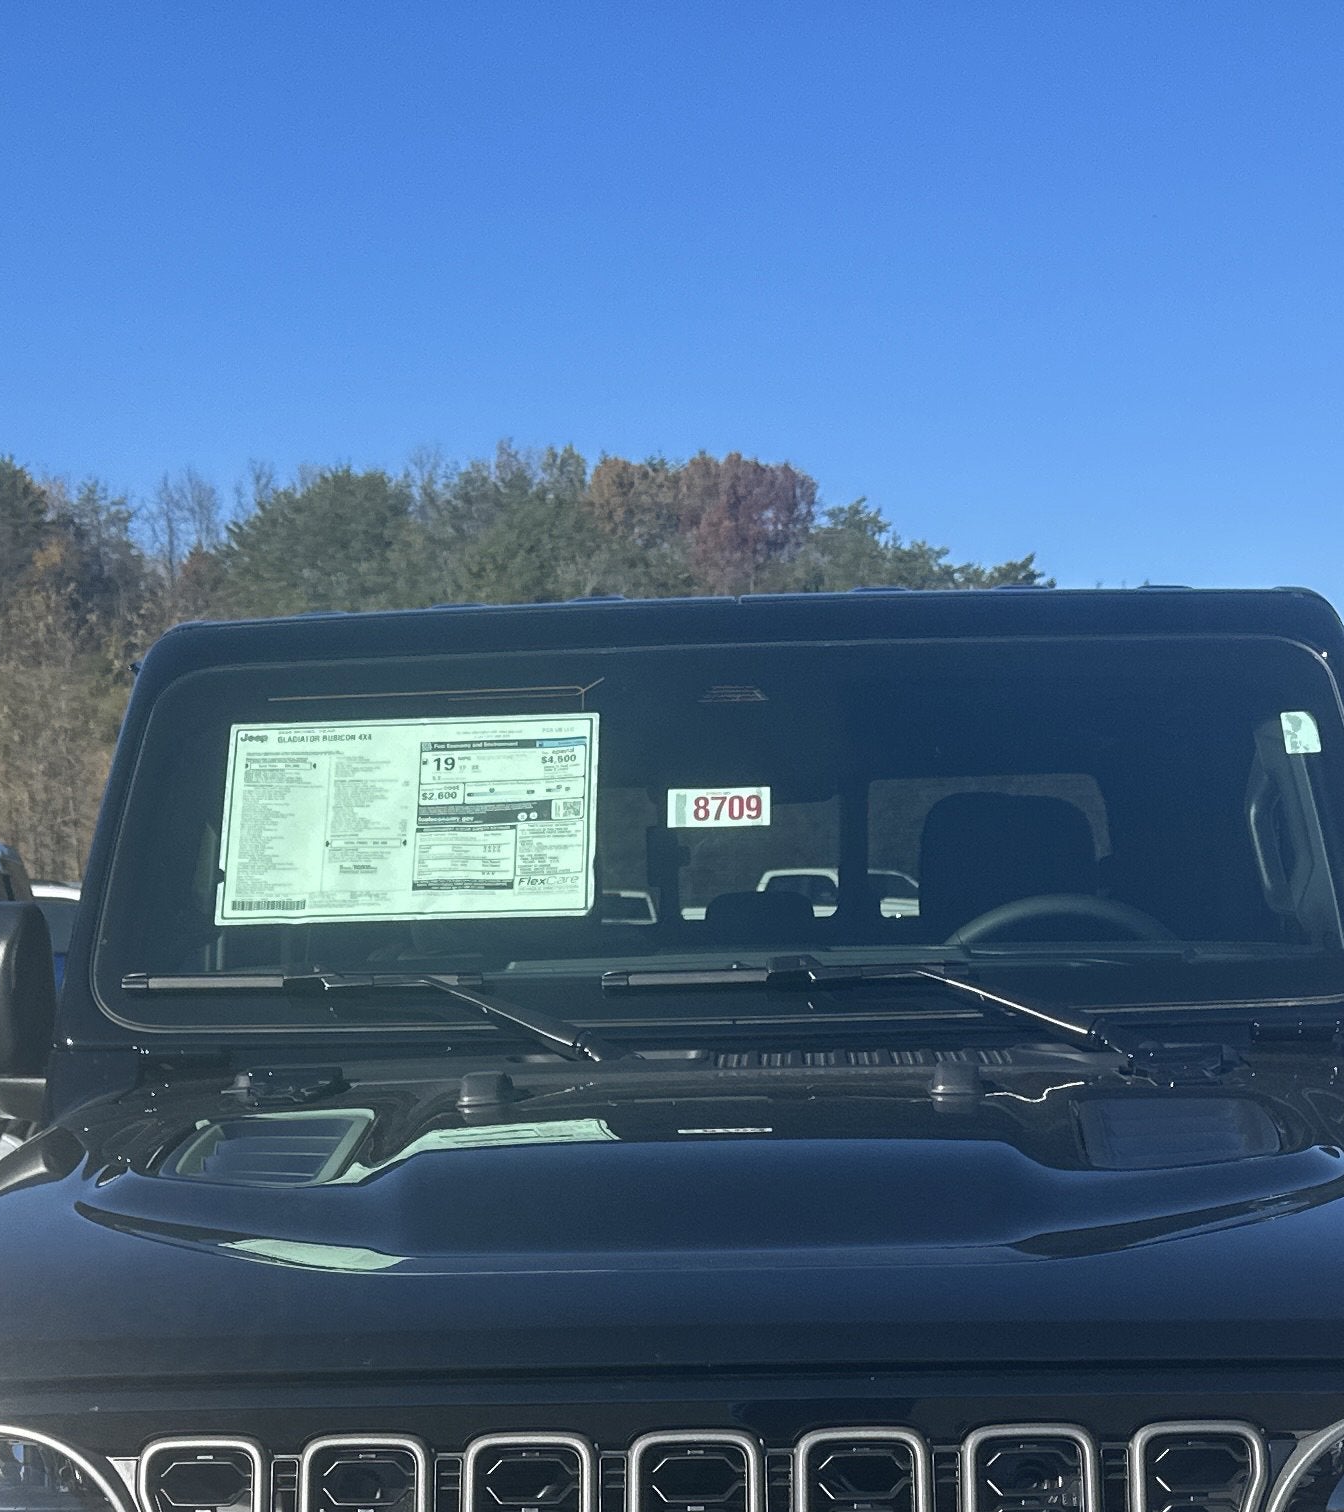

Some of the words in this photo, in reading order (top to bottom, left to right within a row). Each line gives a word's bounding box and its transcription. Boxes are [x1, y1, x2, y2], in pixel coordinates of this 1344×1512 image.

[240, 733, 268, 743] Jeep
[277, 735, 320, 743] GLADIATOR
[322, 734, 356, 742] RUBICON
[358, 733, 372, 741] 4X4
[433, 757, 455, 771] 19
[693, 795, 762, 821] 8709
[518, 876, 579, 886] FlexCare
